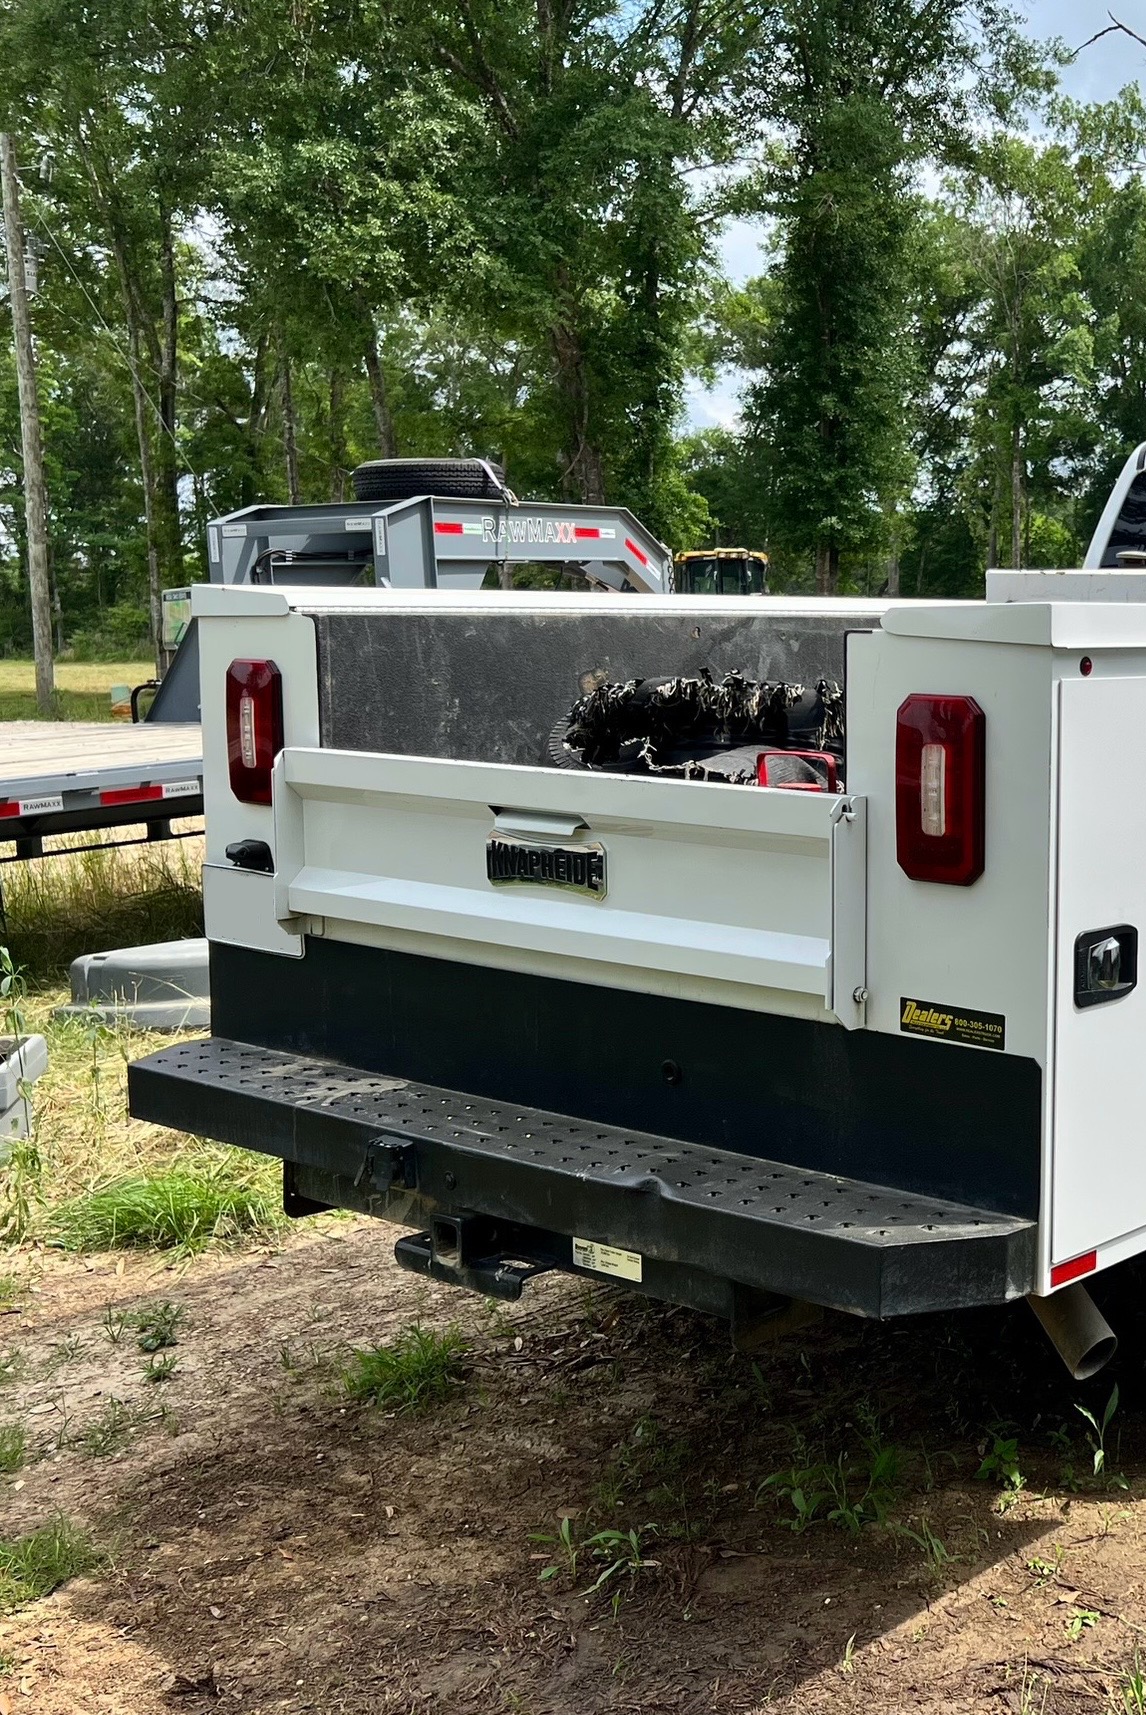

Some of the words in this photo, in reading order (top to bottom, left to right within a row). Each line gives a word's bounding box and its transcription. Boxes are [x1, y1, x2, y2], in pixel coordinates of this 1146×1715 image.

[487, 840, 603, 892] KNAPHEIDE
[901, 1001, 954, 1031] Dealers
[954, 1017, 1003, 1034] 800-305-1070
